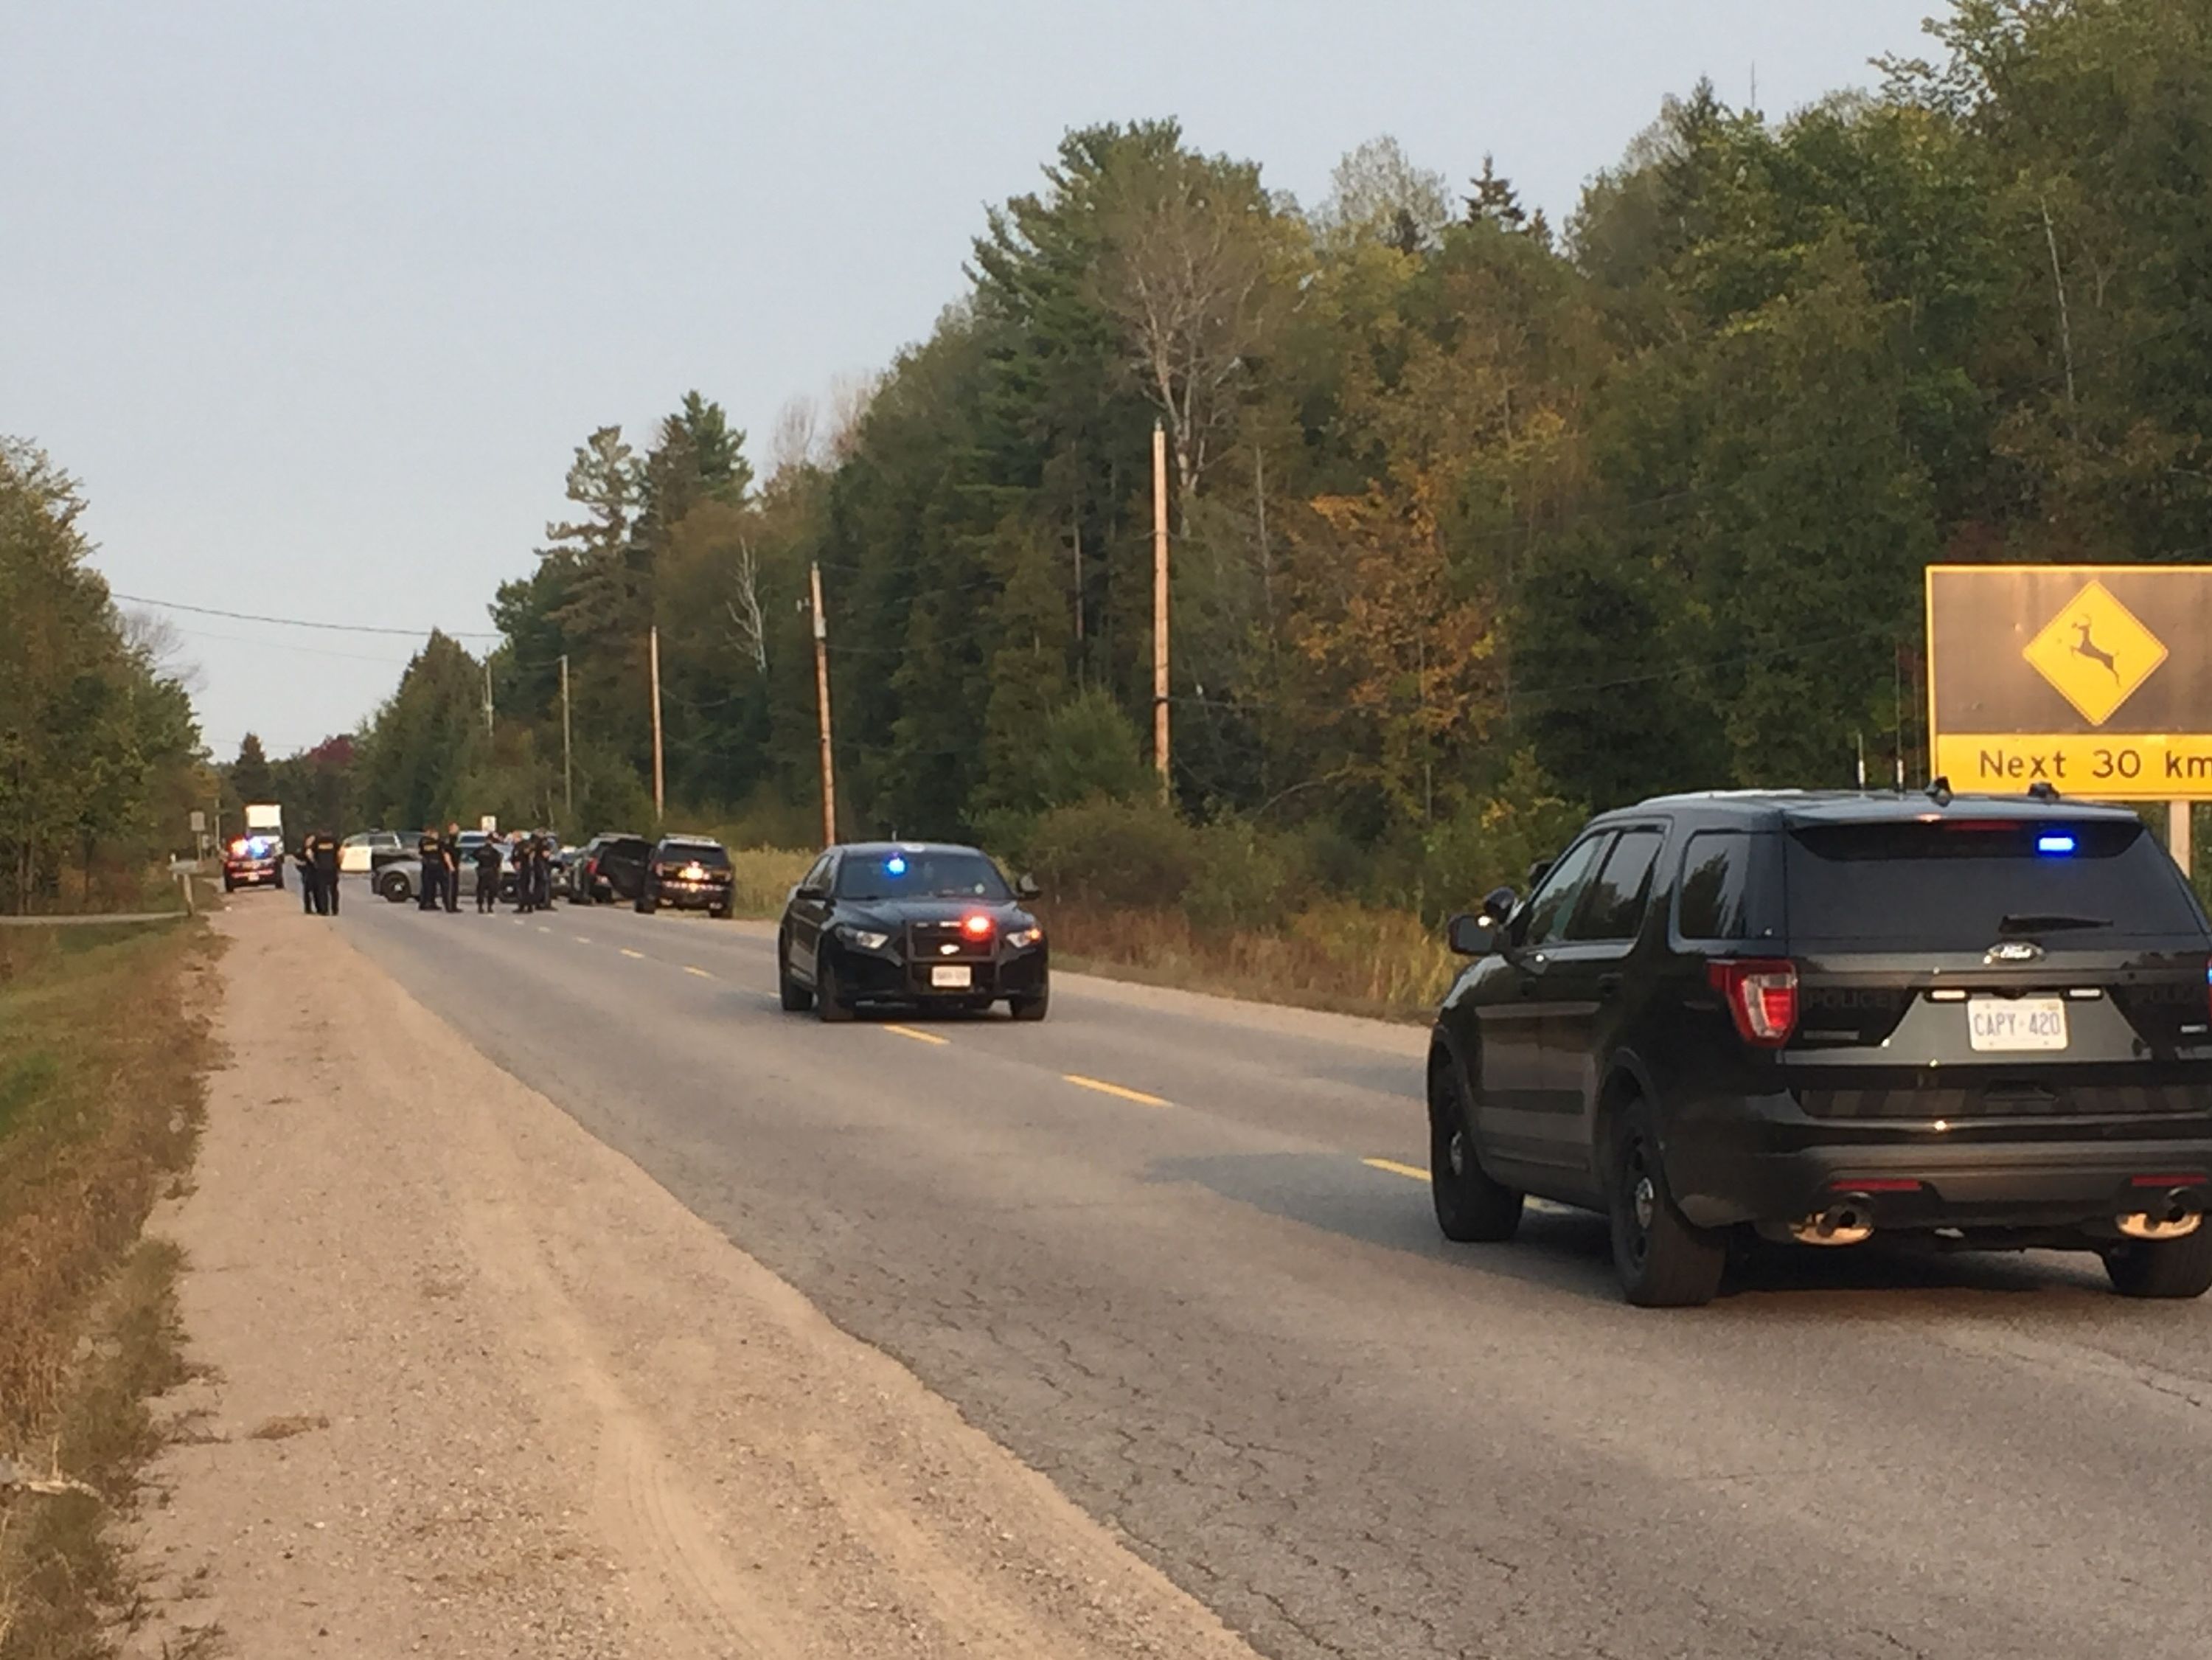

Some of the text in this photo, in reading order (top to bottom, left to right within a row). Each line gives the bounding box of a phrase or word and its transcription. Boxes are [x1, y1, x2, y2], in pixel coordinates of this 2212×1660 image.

[1980, 749, 2212, 778] Next 30 km
[1974, 1012, 2061, 1036] CAPY 420
